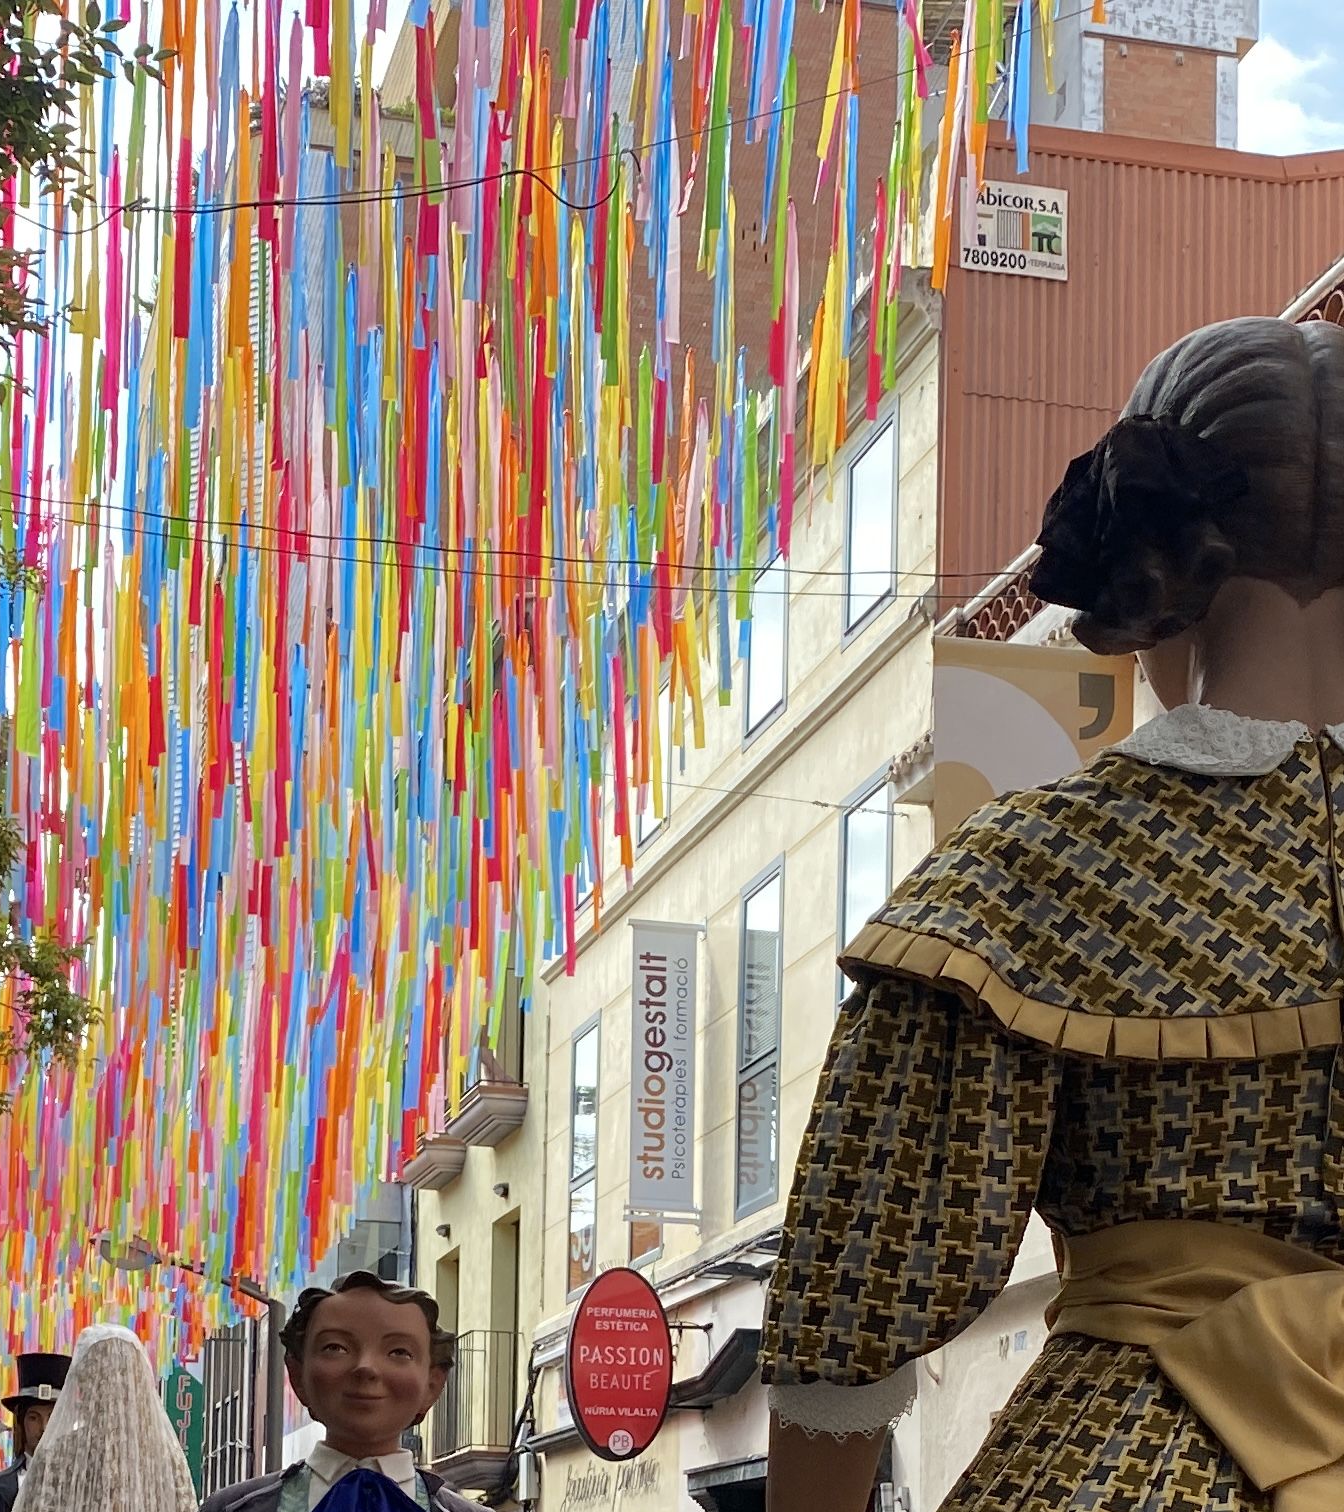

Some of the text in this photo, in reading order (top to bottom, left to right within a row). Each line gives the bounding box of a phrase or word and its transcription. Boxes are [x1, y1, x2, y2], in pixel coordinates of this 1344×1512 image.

[962, 248, 1027, 270] 7809200
[672, 957, 688, 1040] formació
[637, 951, 673, 1181] studiogestalt
[586, 1306, 658, 1319] PERFUMERIA
[579, 1345, 664, 1366] PASSION
[584, 1405, 659, 1417] NÚRIA VILALTA
[612, 1435, 630, 1448] PB
